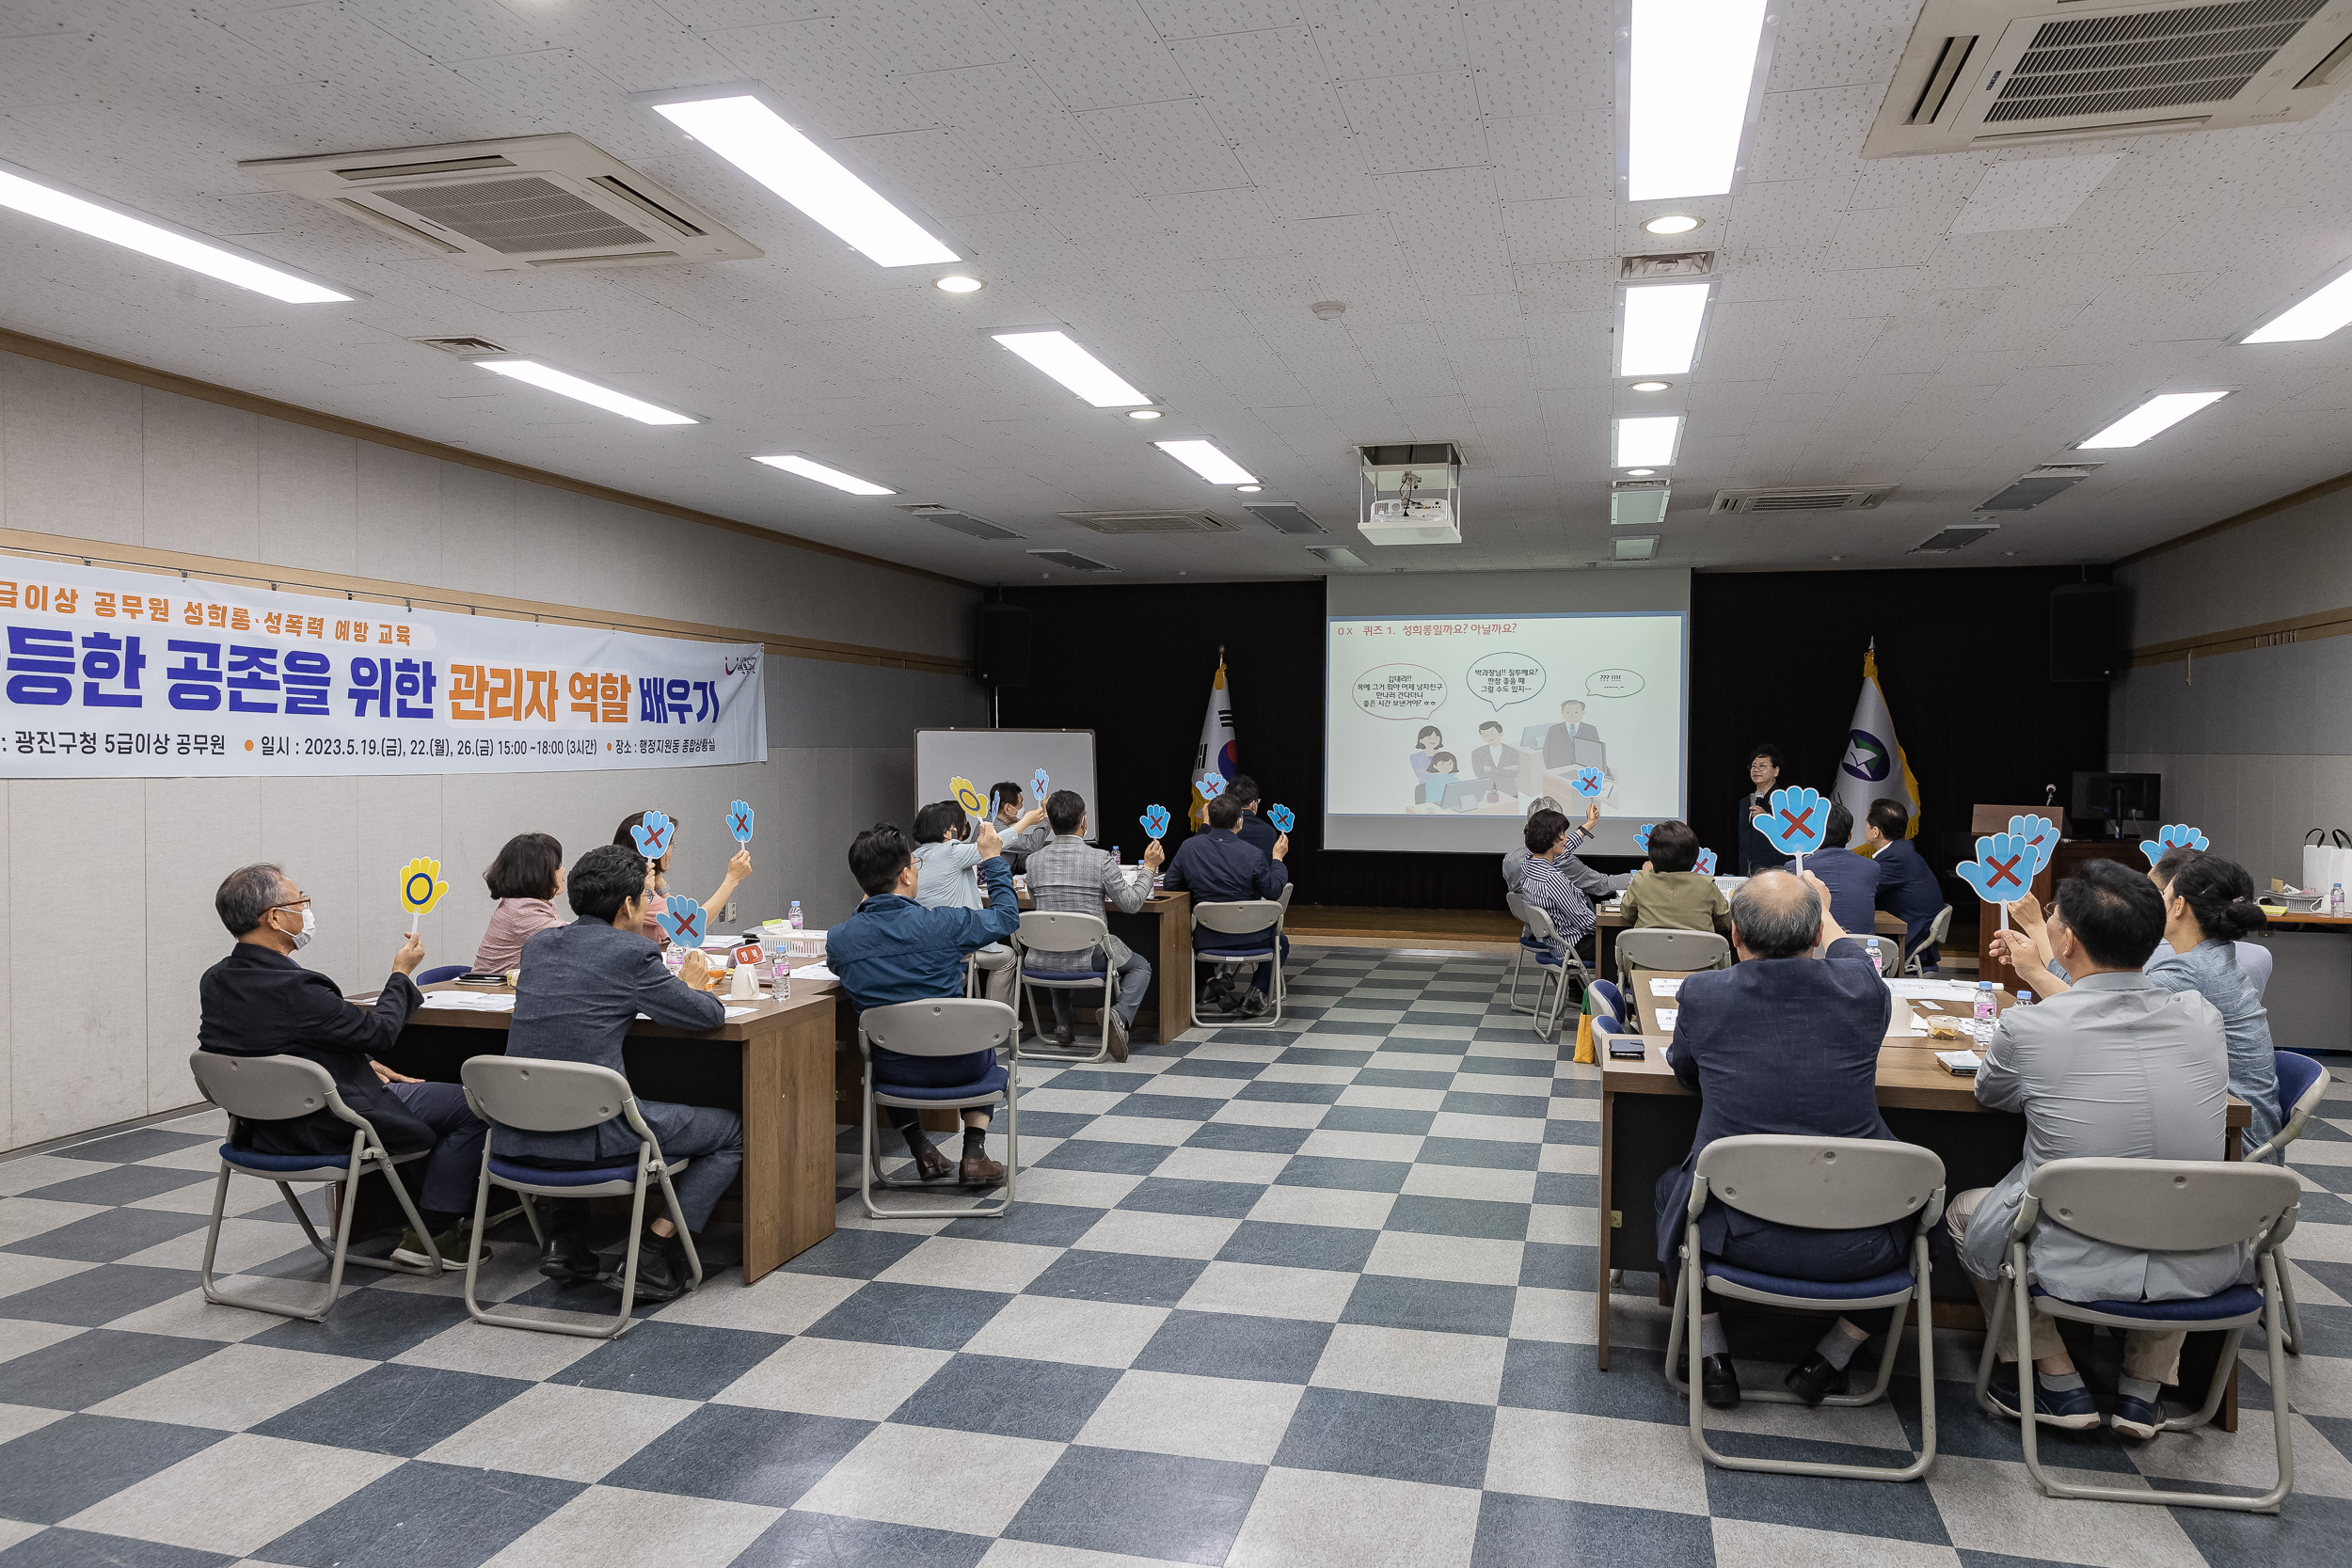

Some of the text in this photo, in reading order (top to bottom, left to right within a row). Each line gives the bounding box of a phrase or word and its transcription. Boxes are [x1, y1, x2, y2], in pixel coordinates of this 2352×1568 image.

[0, 581, 78, 613] 급이상
[95, 592, 168, 622] 공무원
[335, 621, 368, 642] 예방
[379, 625, 410, 645] 교육
[1363, 626, 1383, 637] 퀴즈
[1388, 626, 1396, 636] 1.
[1404, 624, 1468, 636] 성희롱일까요?
[1470, 624, 1517, 635] 아닐까요?
[0, 626, 720, 724] 등한 공존을 위한 관리자 역할 배우기
[1363, 700, 1375, 708] 좋은
[16, 731, 96, 754] 광진구청
[105, 734, 170, 754] 5급이상
[177, 735, 224, 754] 공무원
[262, 736, 289, 755] 일시
[305, 737, 405, 757] 2023.5.19.(금),
[411, 738, 453, 757] 22.(월),
[458, 739, 493, 756] 26.(금)
[499, 741, 527, 754] 15:00
[531, 741, 564, 754] ~18:00
[567, 739, 596, 755] (3시간)
[616, 740, 631, 753] 장소
[640, 739, 679, 753] 행정지원동
[682, 738, 715, 752] 종합상황실
